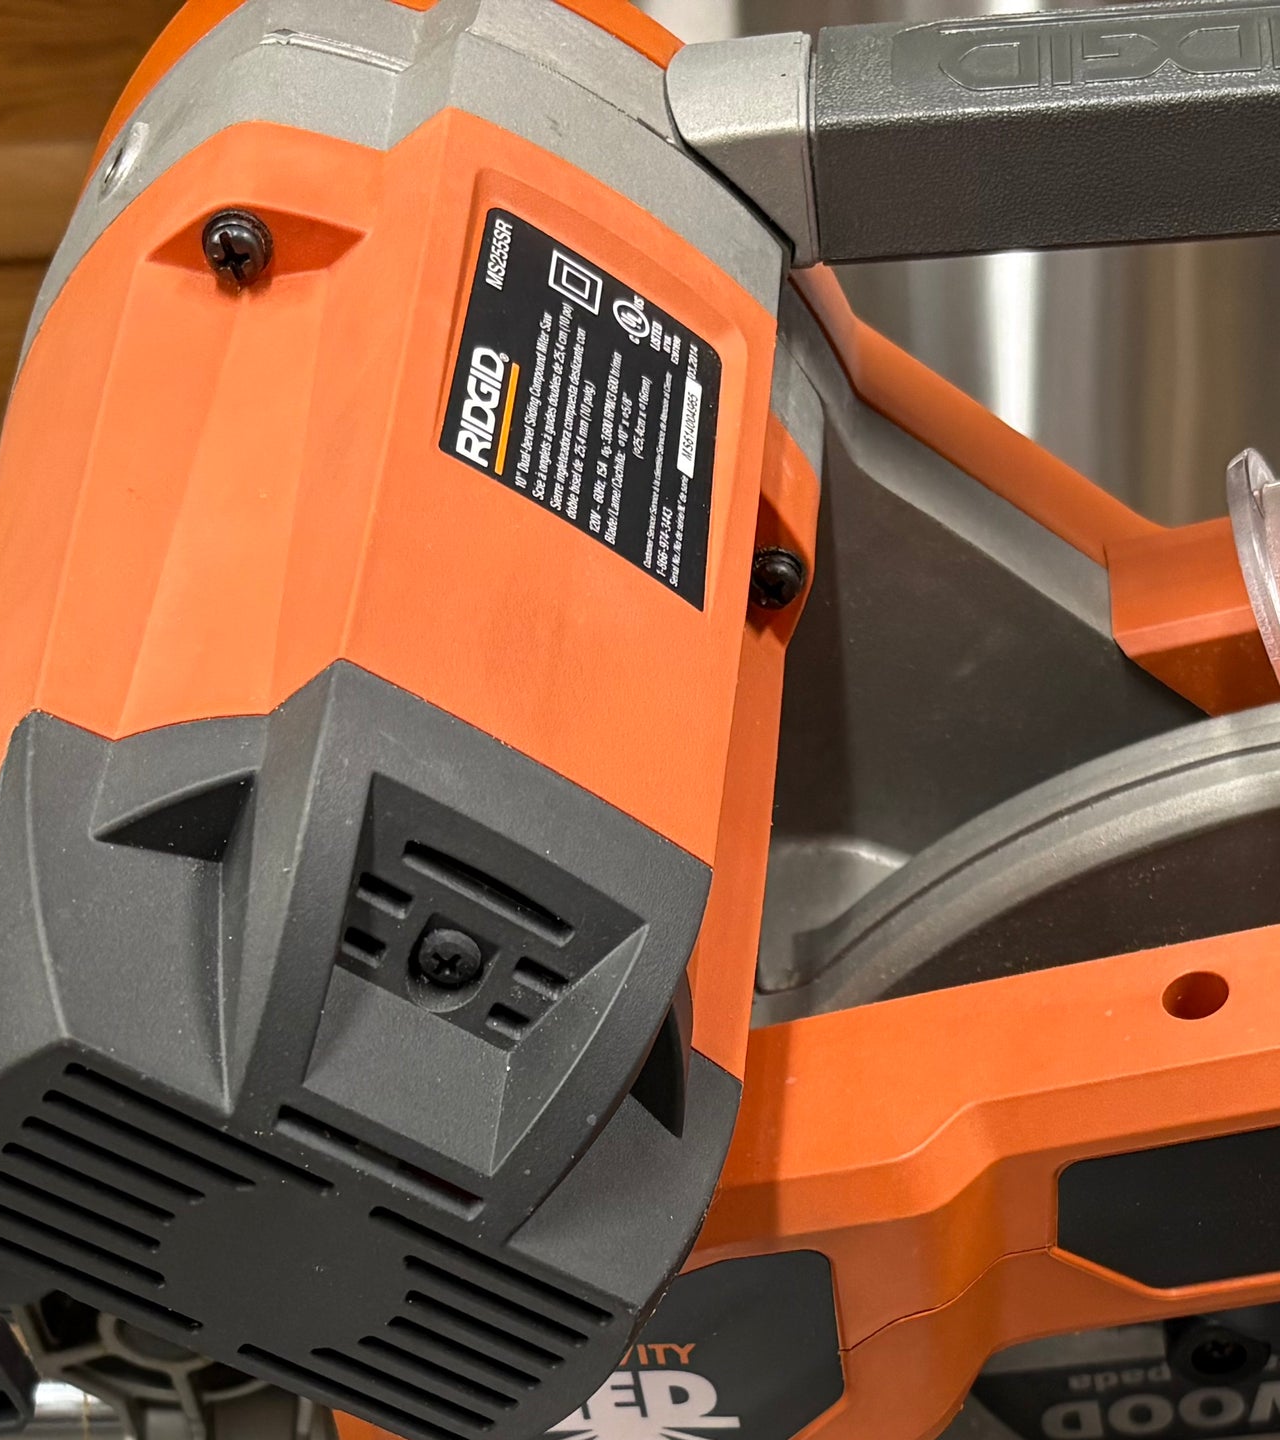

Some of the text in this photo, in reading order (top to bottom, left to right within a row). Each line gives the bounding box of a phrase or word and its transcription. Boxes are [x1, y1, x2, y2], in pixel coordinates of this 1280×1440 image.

[485, 218, 512, 290] MS255SR
[539, 311, 552, 331] Saw
[576, 326, 585, 344] con
[535, 329, 549, 354] Miter
[553, 342, 566, 364] 25,4
[528, 350, 546, 397] Compound
[551, 361, 563, 374] de
[568, 343, 584, 385] deslizante
[546, 372, 561, 407] doubles
[524, 395, 541, 426] Sliding
[543, 405, 556, 435] guides
[563, 384, 578, 430] compuesta
[516, 424, 534, 473] Dual-bevel
[538, 440, 551, 473] onglets
[573, 435, 586, 458] 25,4
[571, 458, 583, 472] de
[531, 479, 545, 500] Scie
[568, 469, 581, 494] bisel
[589, 508, 601, 533] 120V
[596, 460, 607, 478] 15A
[565, 492, 578, 519] doble
[655, 505, 672, 577] 1-866-974-3443
